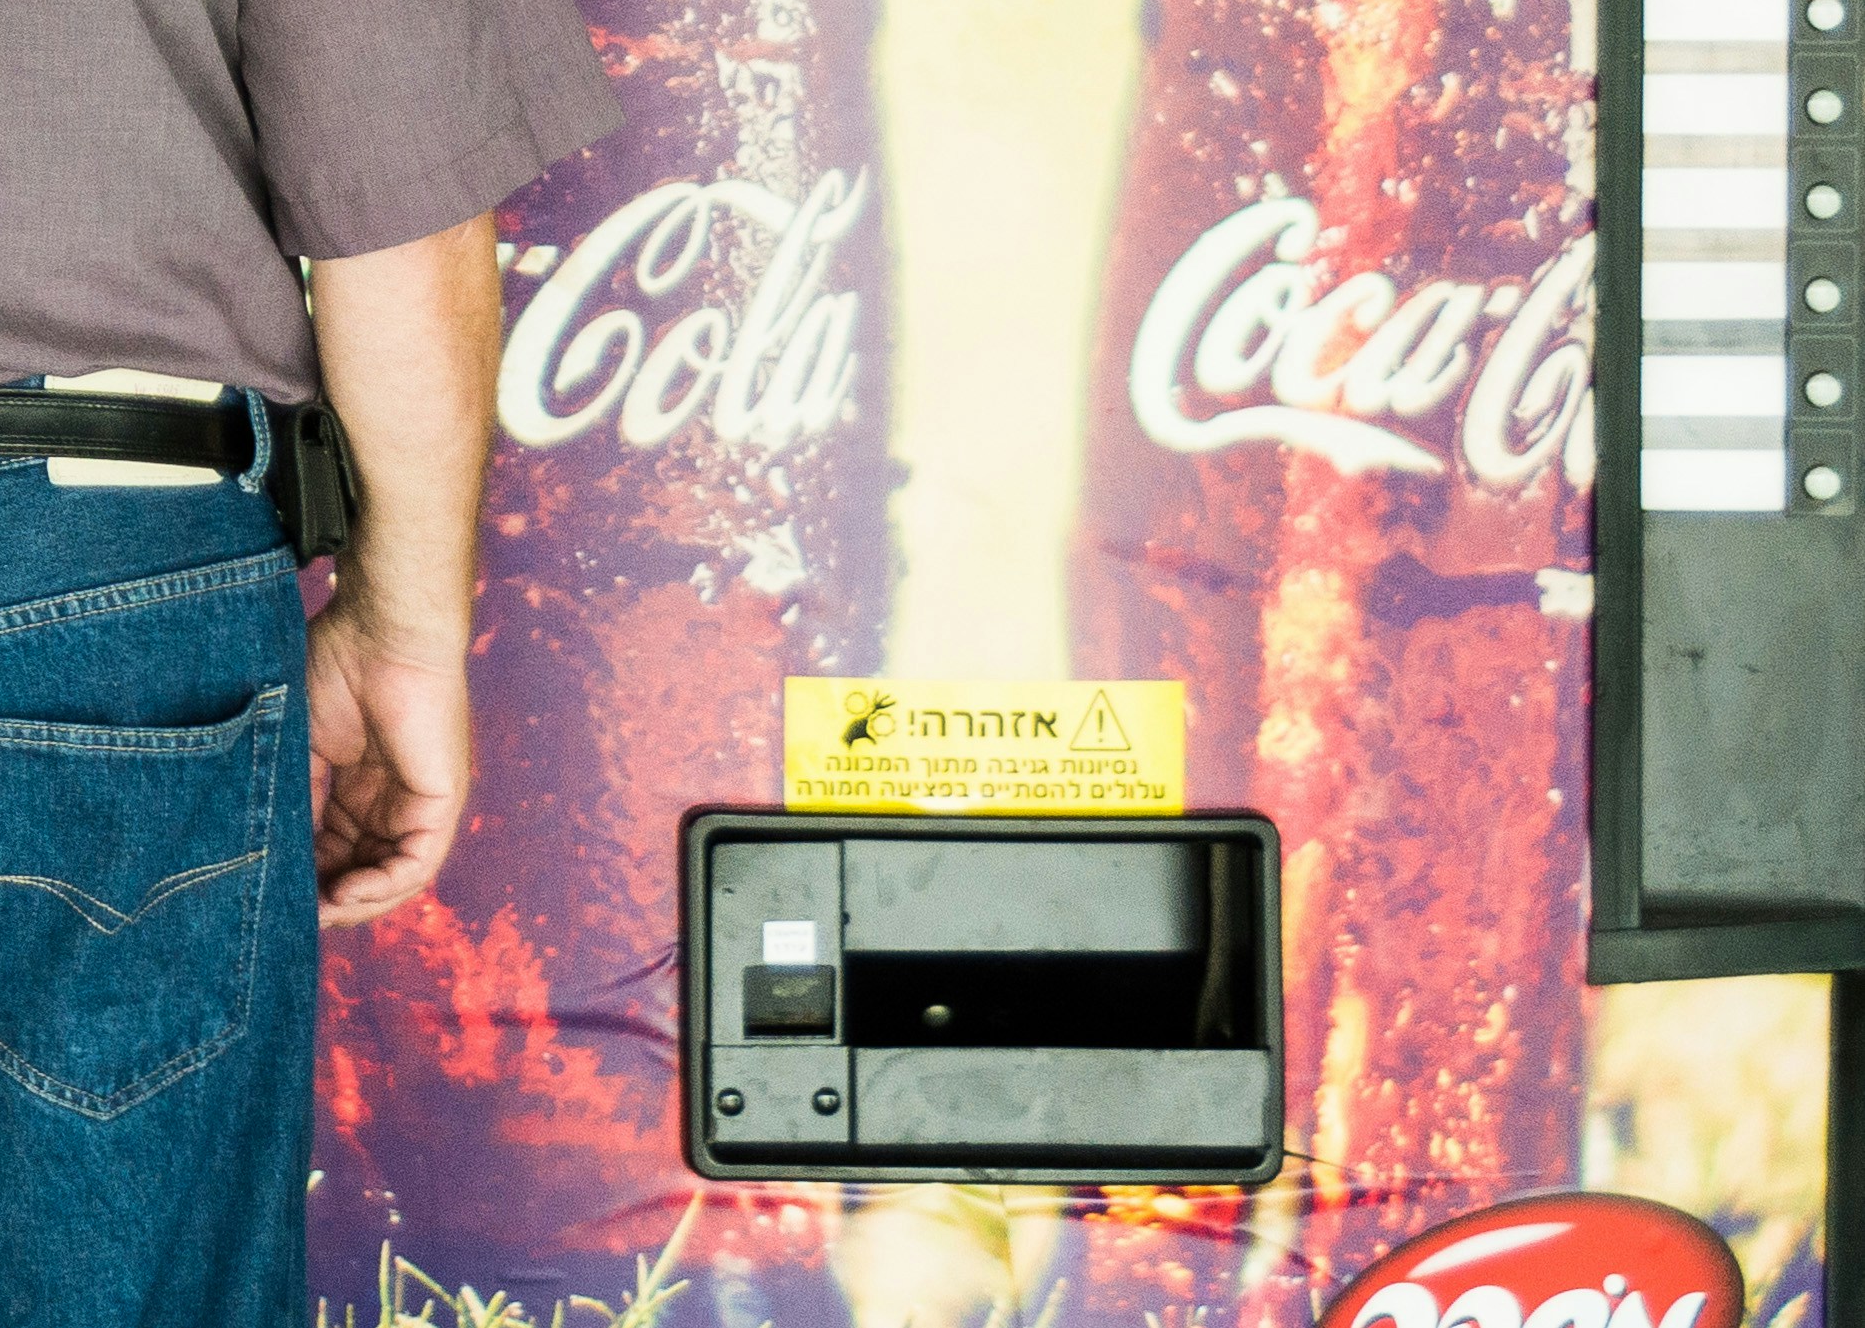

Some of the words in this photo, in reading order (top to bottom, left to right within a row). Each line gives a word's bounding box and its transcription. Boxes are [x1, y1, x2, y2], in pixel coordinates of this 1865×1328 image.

[908, 709, 1058, 739] אזהרה!
[826, 755, 910, 773] המכונה
[921, 755, 977, 778] מתוך
[987, 756, 1050, 775] גניבה
[1061, 757, 1139, 776] נסיונות
[797, 779, 870, 797] חמורה
[882, 779, 969, 799] בפציעה
[981, 777, 1081, 800] להסתיים
[1090, 779, 1166, 802] עלולים
